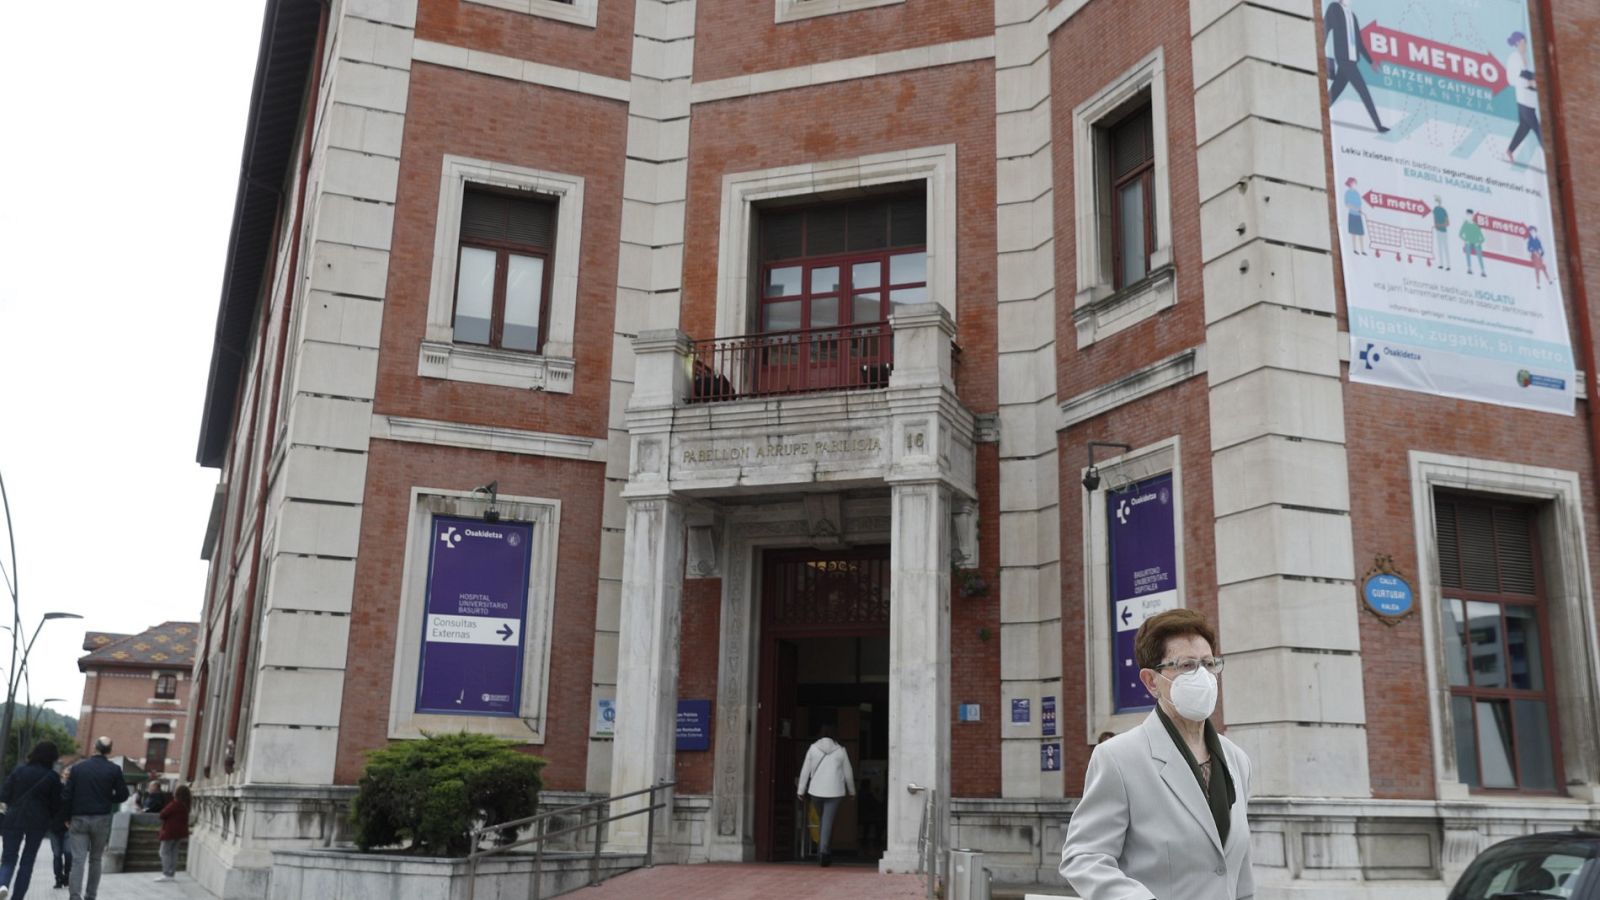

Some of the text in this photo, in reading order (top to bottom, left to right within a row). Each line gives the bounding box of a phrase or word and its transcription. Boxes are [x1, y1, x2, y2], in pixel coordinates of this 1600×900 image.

[1370, 32, 1499, 83] BI METRO
[1382, 64, 1493, 100] BATZEN GAITUEN
[1384, 76, 1493, 112] DISTANTZIA
[1403, 167, 1492, 194] ERABILI MASKARA
[1370, 193, 1425, 213] Bi metro
[1477, 215, 1527, 235] Bi metro
[1475, 289, 1515, 305] ISOLATU
[1358, 314, 1424, 339] Nigatik,
[1498, 338, 1513, 354] bi
[906, 432, 924, 449] 16
[756, 443, 808, 458] ARRUPE
[465, 529, 503, 539] Osakidetza
[458, 600, 508, 610] UNIVERSITARIO
[459, 593, 490, 601] HOSPITAL
[458, 606, 489, 615] BASURTO
[433, 617, 477, 629] Consultas
[432, 628, 470, 639] Externas
